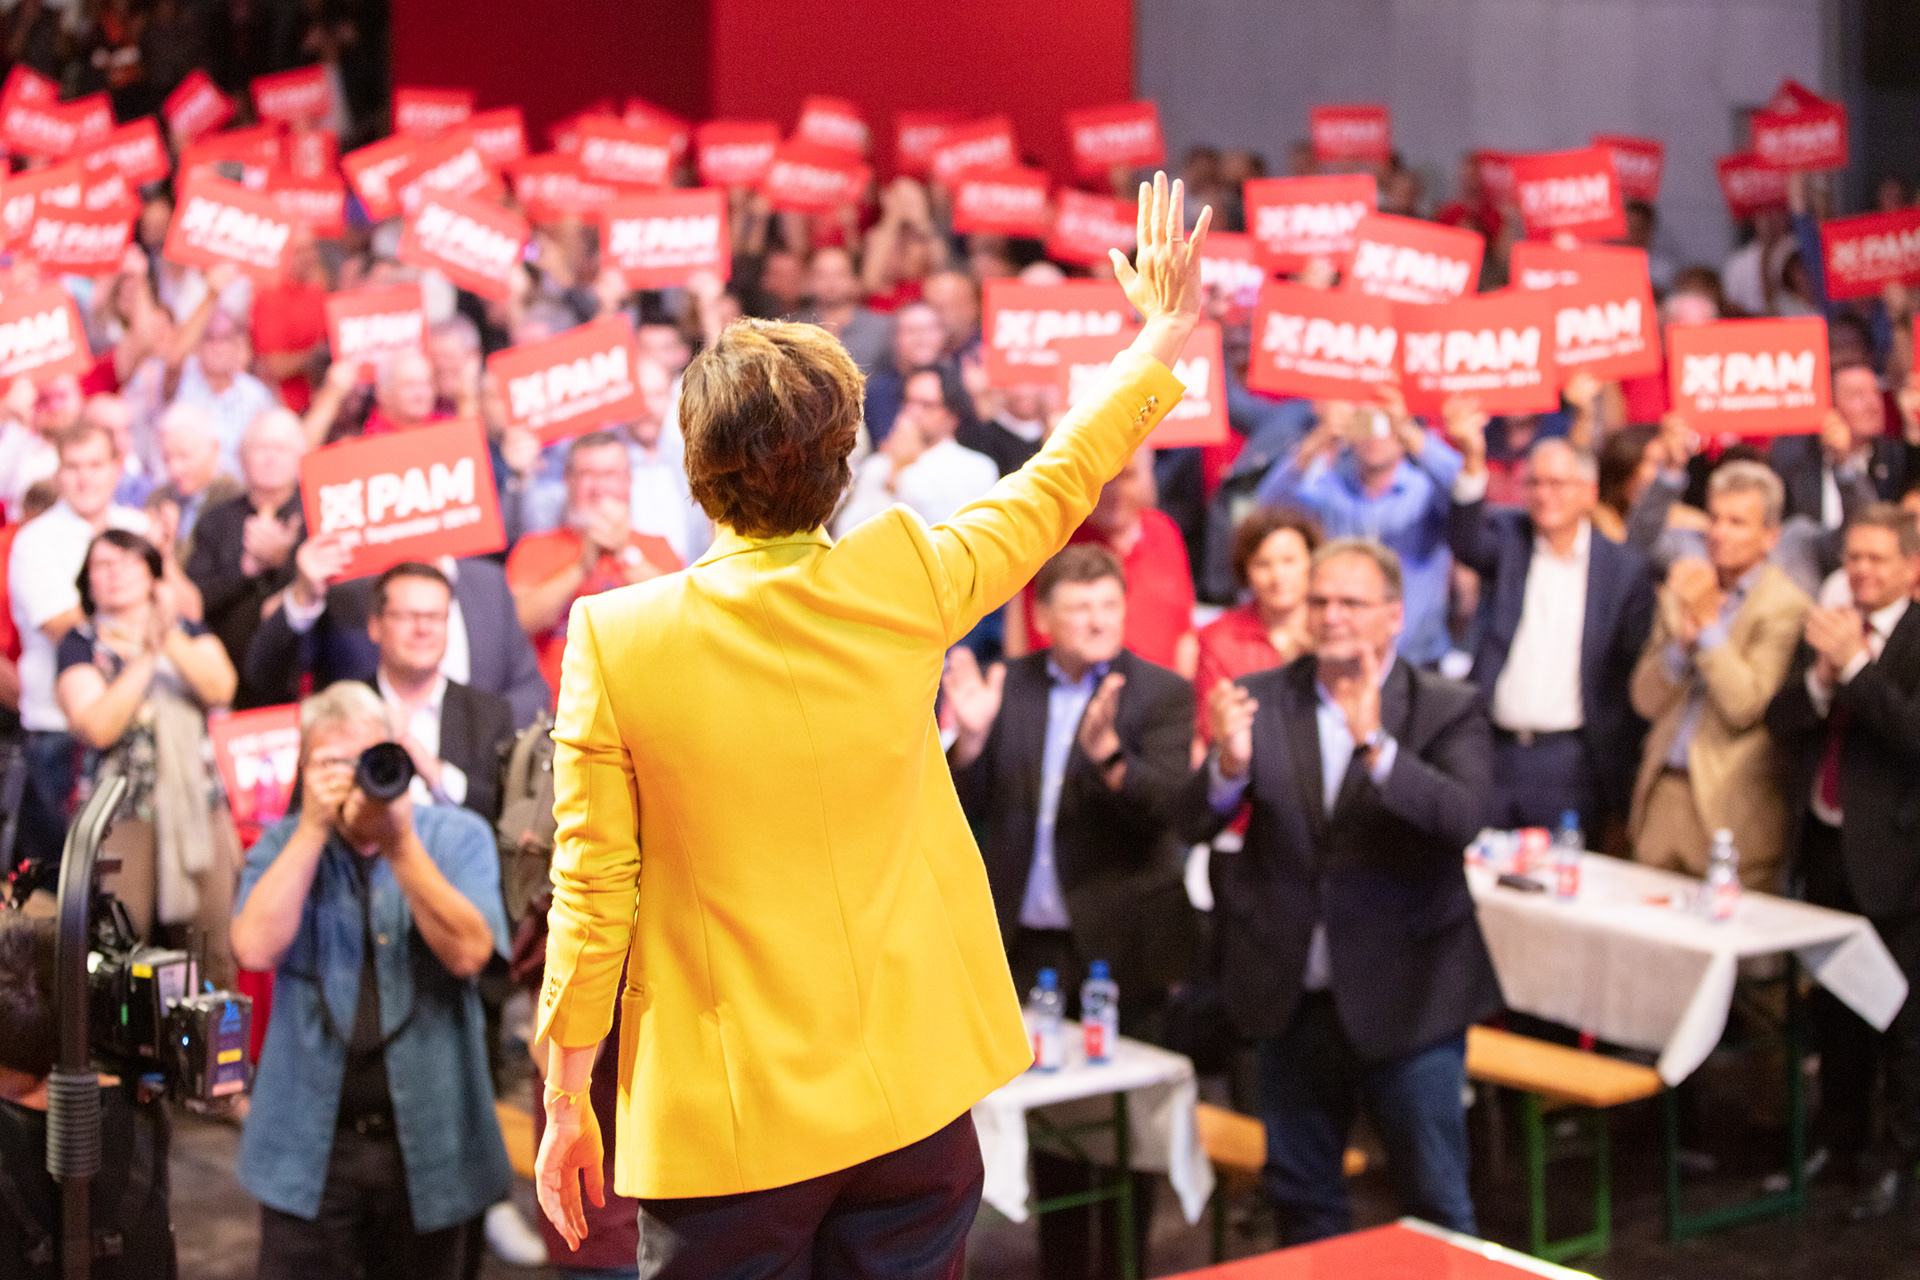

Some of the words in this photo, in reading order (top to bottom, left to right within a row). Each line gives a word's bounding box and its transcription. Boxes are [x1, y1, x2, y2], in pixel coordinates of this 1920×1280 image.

[1304, 318, 1398, 369] PAM
[1555, 298, 1642, 348] PAM
[1443, 325, 1542, 373] PAM
[1722, 349, 1816, 394] PAM
[367, 456, 475, 523] PAM
